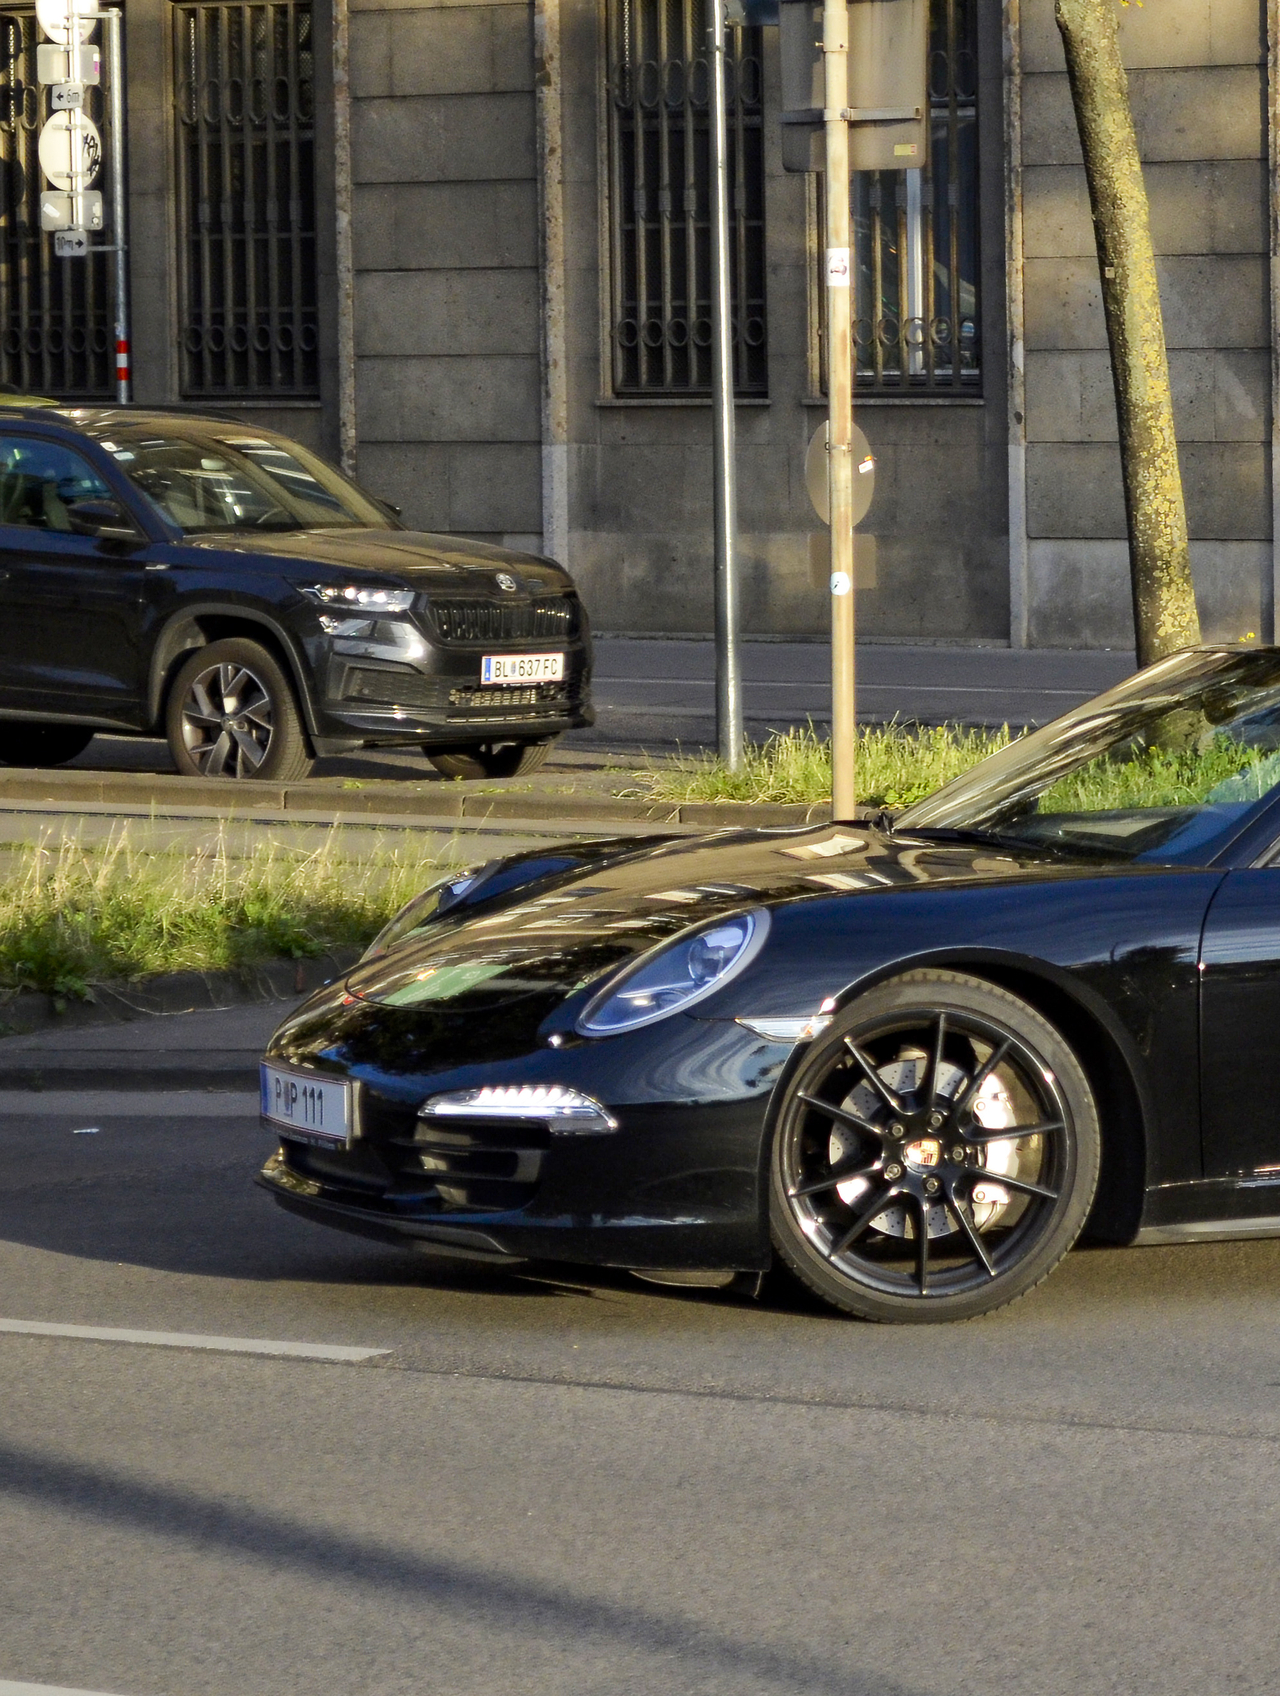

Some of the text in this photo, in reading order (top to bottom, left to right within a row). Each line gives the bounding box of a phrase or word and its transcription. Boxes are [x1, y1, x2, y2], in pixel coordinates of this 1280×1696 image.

[67, 89, 79, 103] 6m
[495, 661, 508, 678] BL
[519, 660, 540, 676] 637
[543, 659, 557, 675] FC
[302, 1084, 324, 1125] 111
